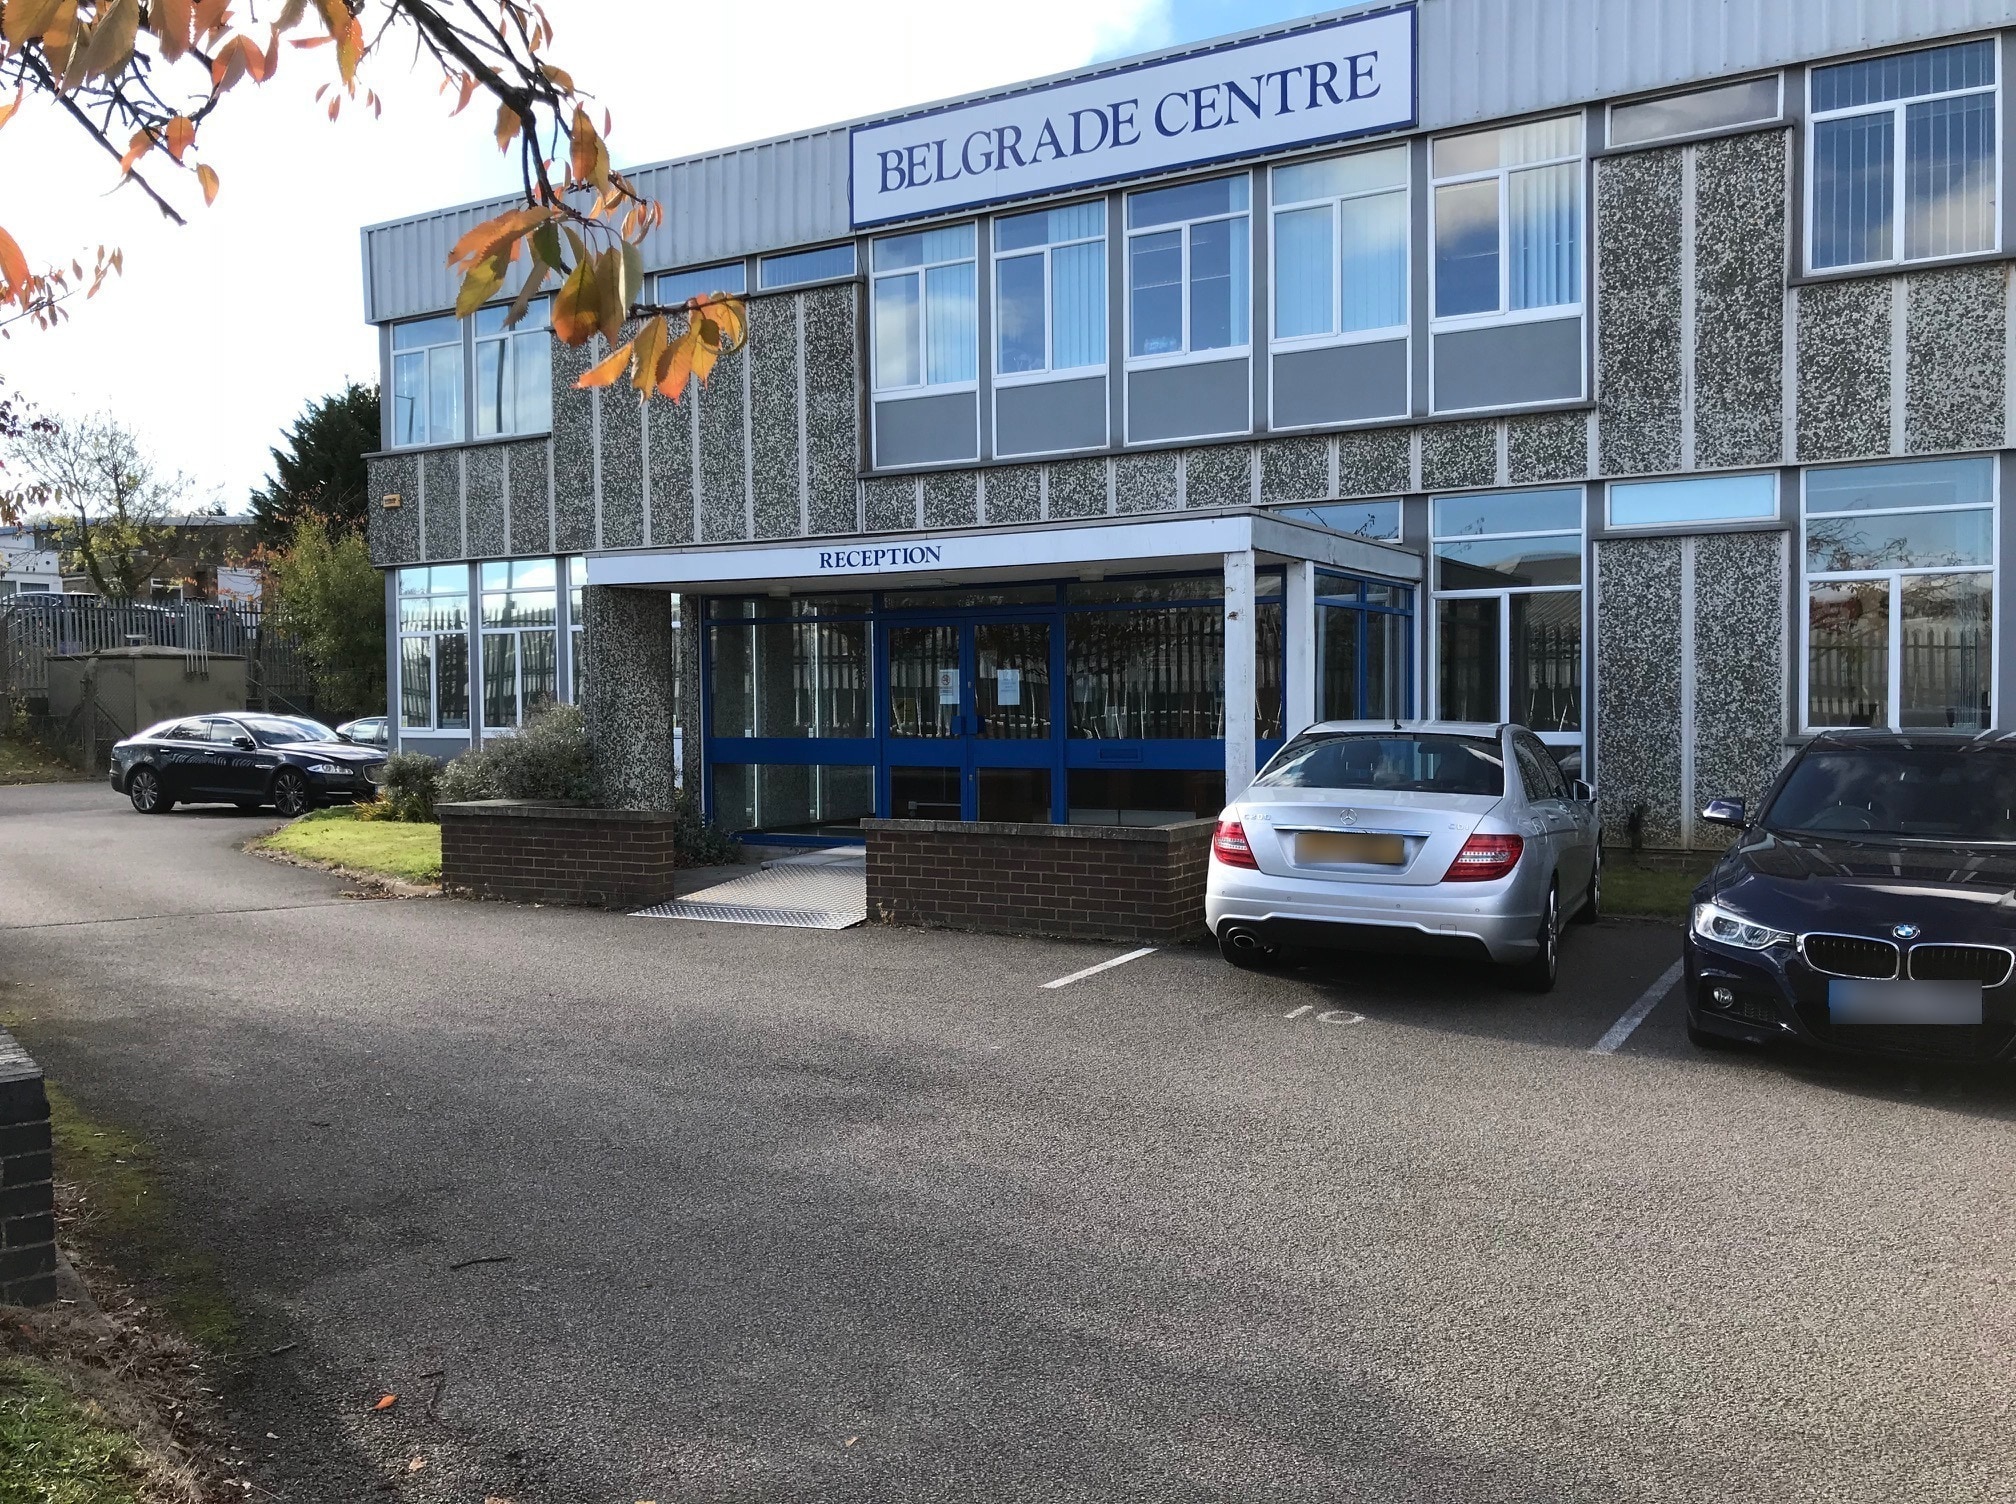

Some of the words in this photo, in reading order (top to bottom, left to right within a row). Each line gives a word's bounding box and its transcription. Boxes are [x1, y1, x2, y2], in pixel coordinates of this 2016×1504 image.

[877, 98, 1141, 194] BELGRADE
[1155, 50, 1381, 137] CENTRE
[819, 545, 942, 569] RECEPTION
